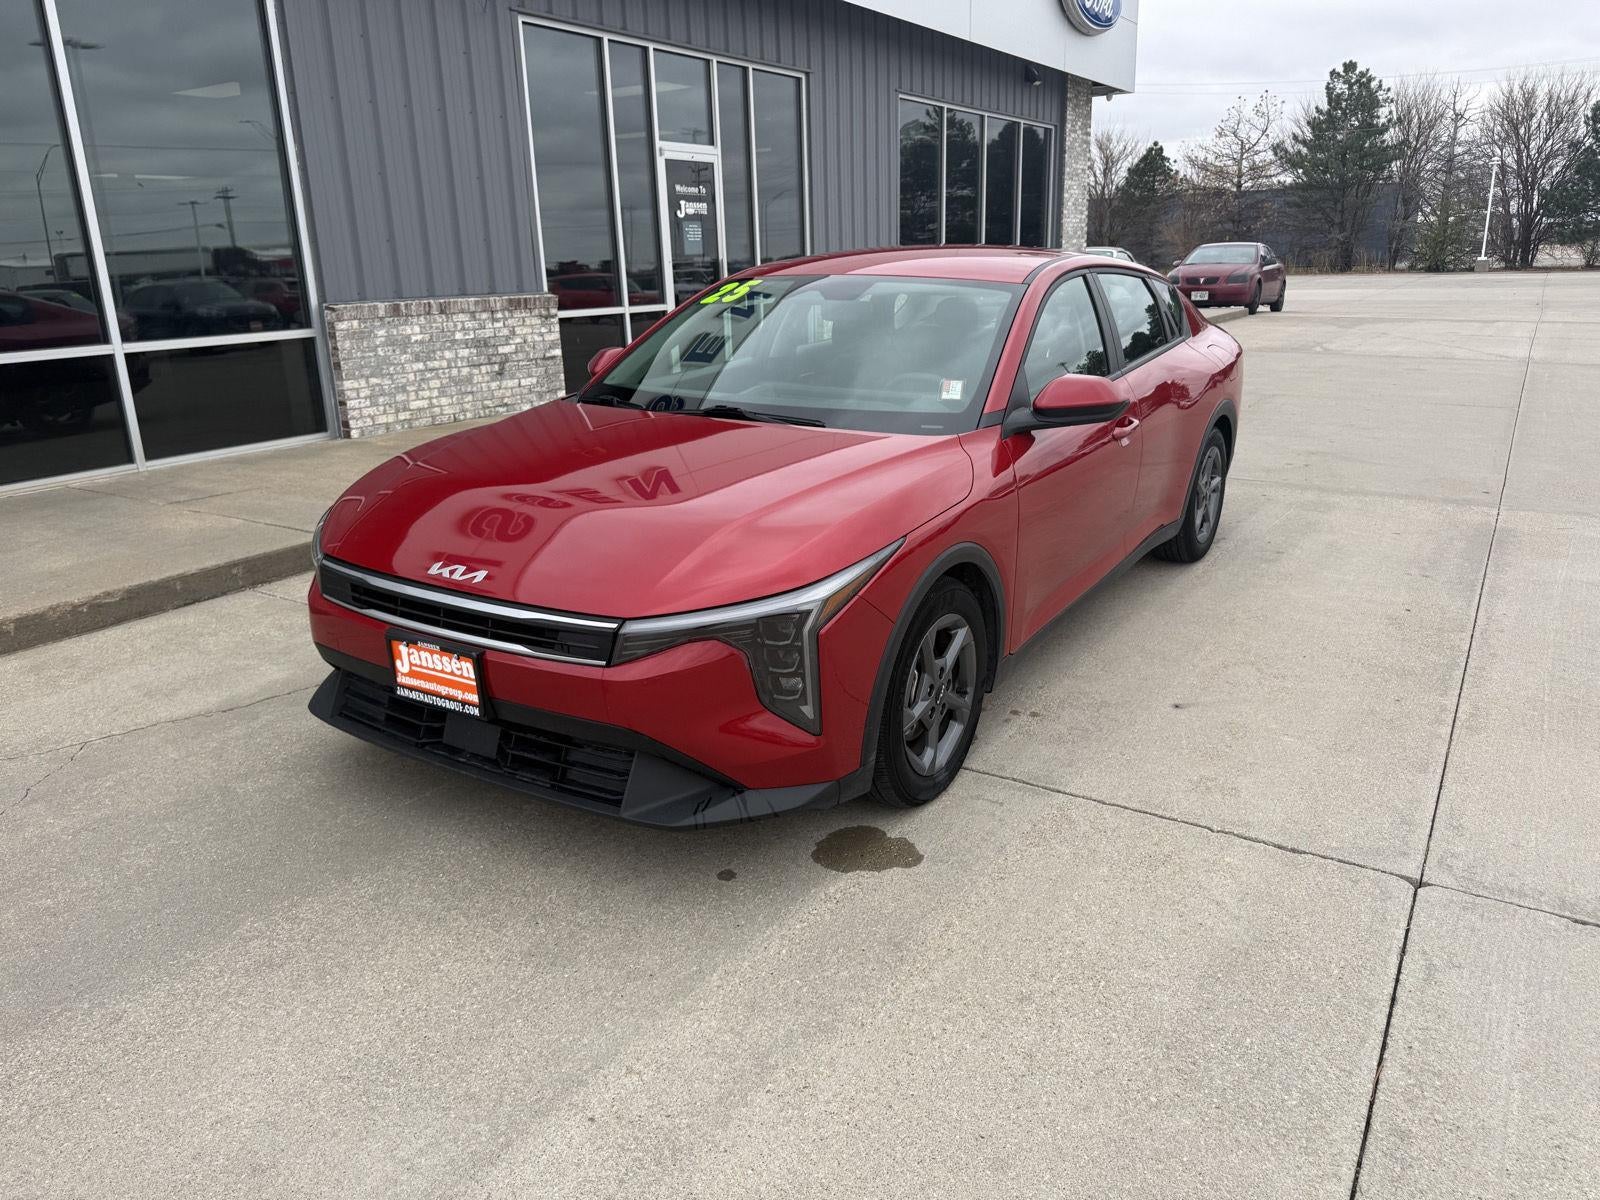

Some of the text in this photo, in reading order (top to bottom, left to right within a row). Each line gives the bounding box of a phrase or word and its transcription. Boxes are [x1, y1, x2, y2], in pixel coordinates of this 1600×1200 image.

[675, 184, 706, 194] Welcome To
[677, 200, 708, 218] Janssen
[700, 280, 763, 305] 25
[427, 561, 488, 583] KIA
[395, 644, 475, 679] Janssen
[396, 673, 478, 702] Janssenautogroup.com
